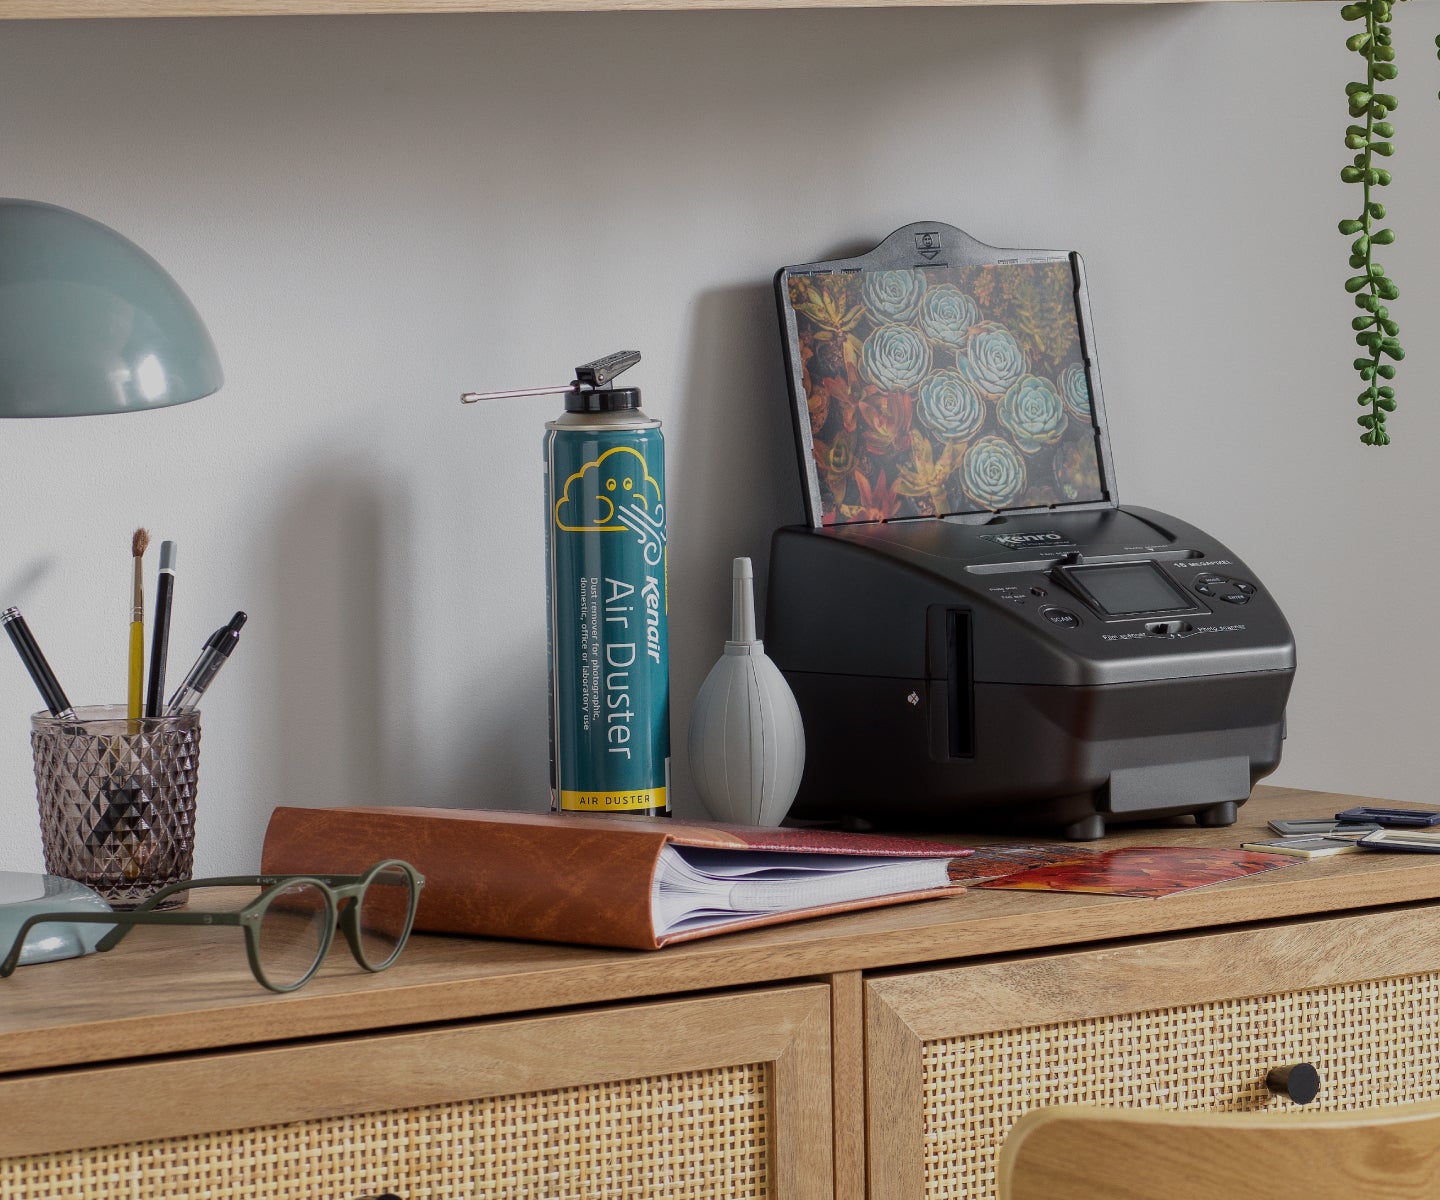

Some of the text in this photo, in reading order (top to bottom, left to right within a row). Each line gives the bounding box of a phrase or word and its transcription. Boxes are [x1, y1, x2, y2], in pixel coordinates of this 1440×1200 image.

[998, 532, 1061, 543] Kenro
[580, 577, 588, 621] domestic,
[590, 577, 598, 598] Dust
[641, 576, 660, 664] Kenair
[582, 652, 588, 660] or
[592, 643, 600, 657] for
[605, 577, 636, 760] Air Duster
[581, 665, 590, 715] laboratory
[591, 659, 600, 721] photographic,
[579, 794, 651, 805] AIR DUSTER
